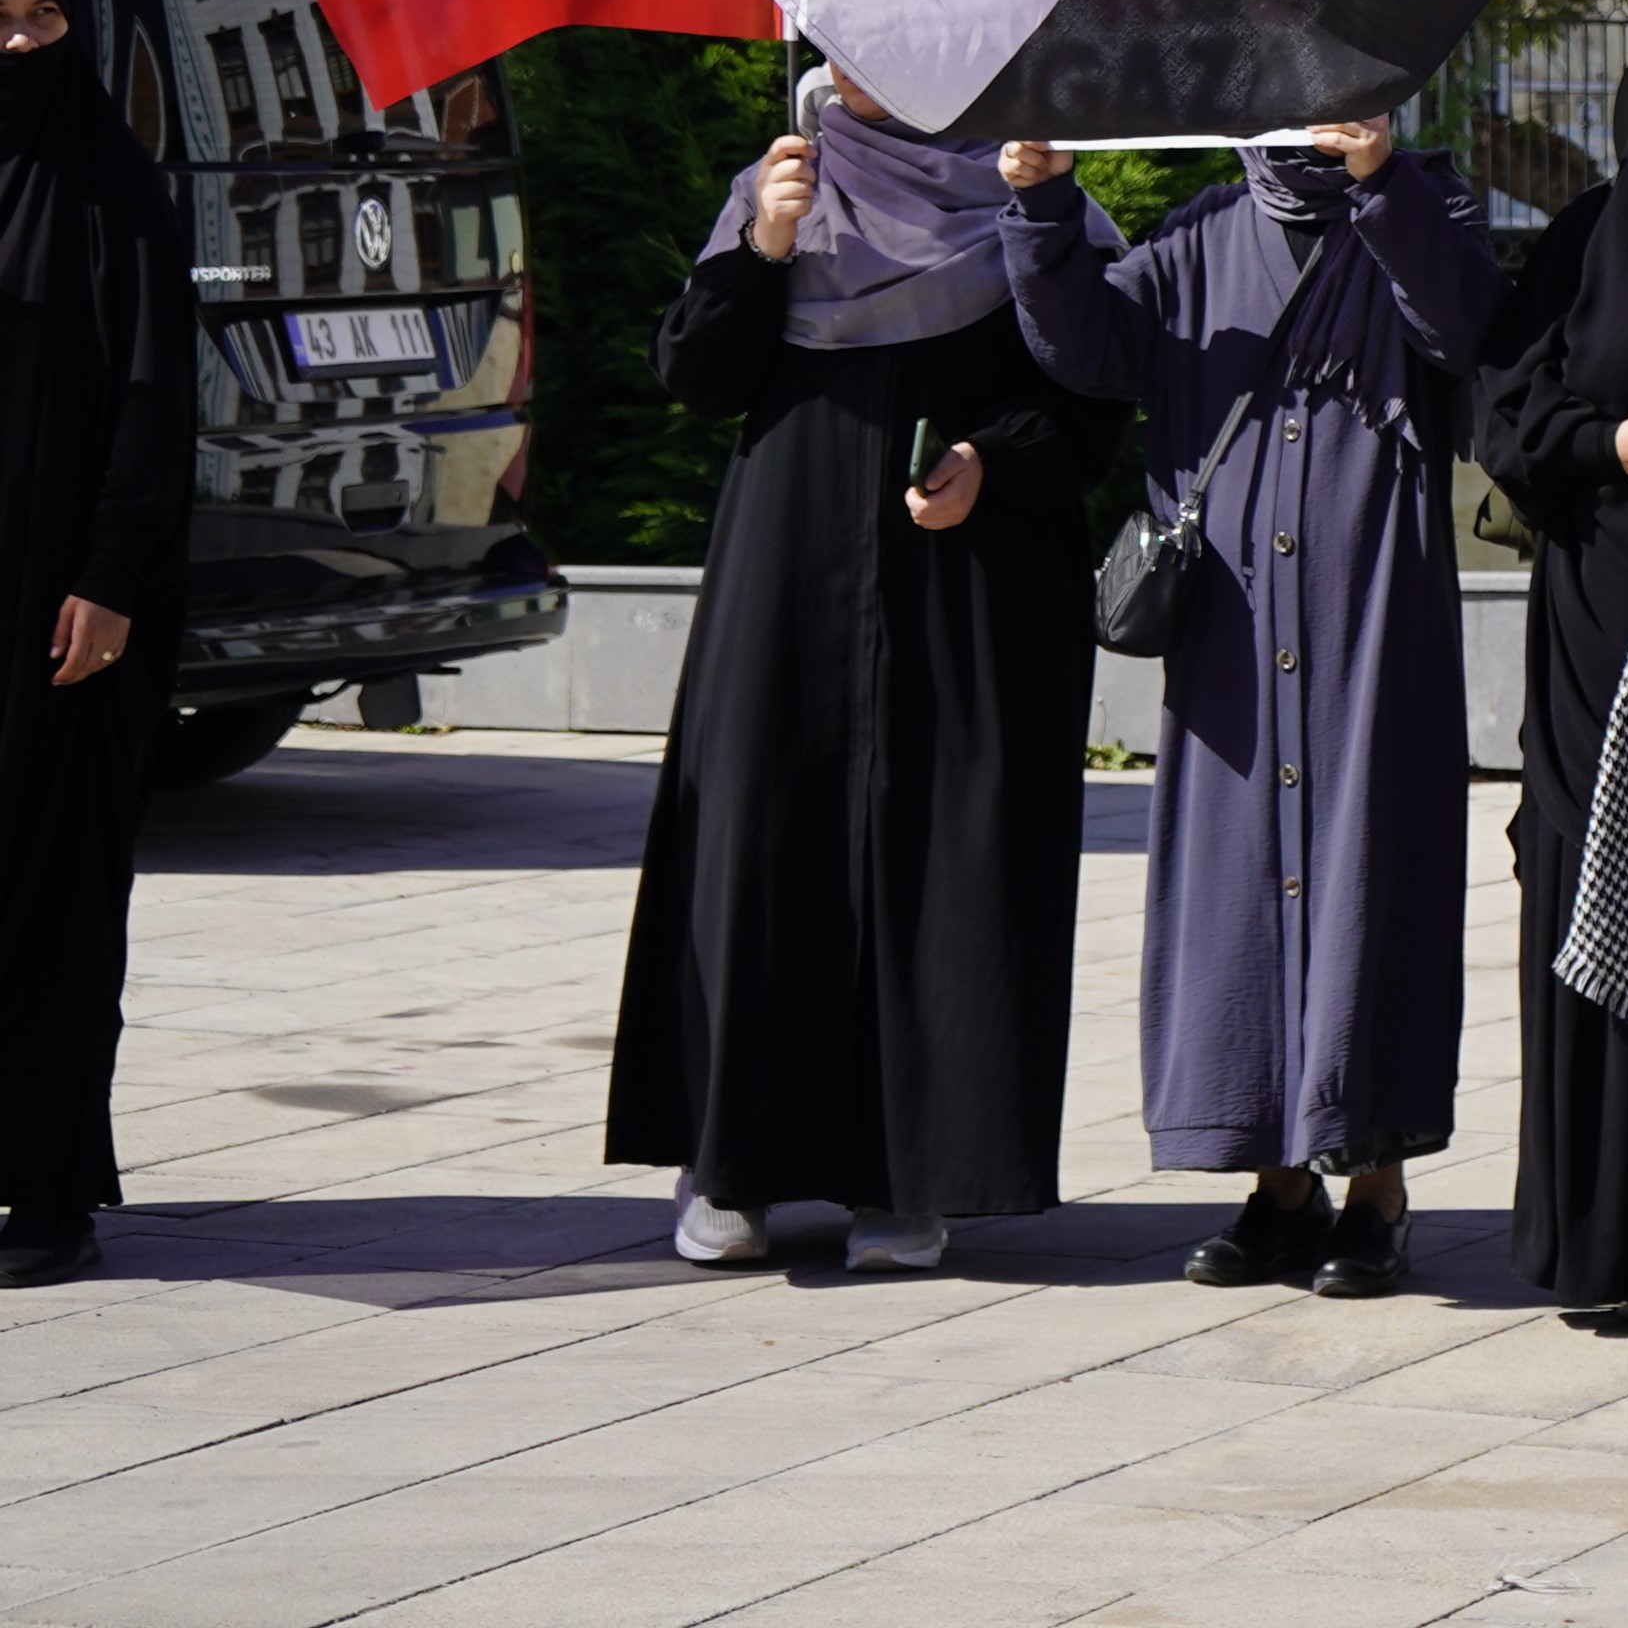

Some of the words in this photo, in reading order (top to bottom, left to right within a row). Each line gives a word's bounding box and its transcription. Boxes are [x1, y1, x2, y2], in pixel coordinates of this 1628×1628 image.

[306, 318, 336, 359] 43
[350, 314, 379, 357] AK
[391, 312, 429, 354] 111
